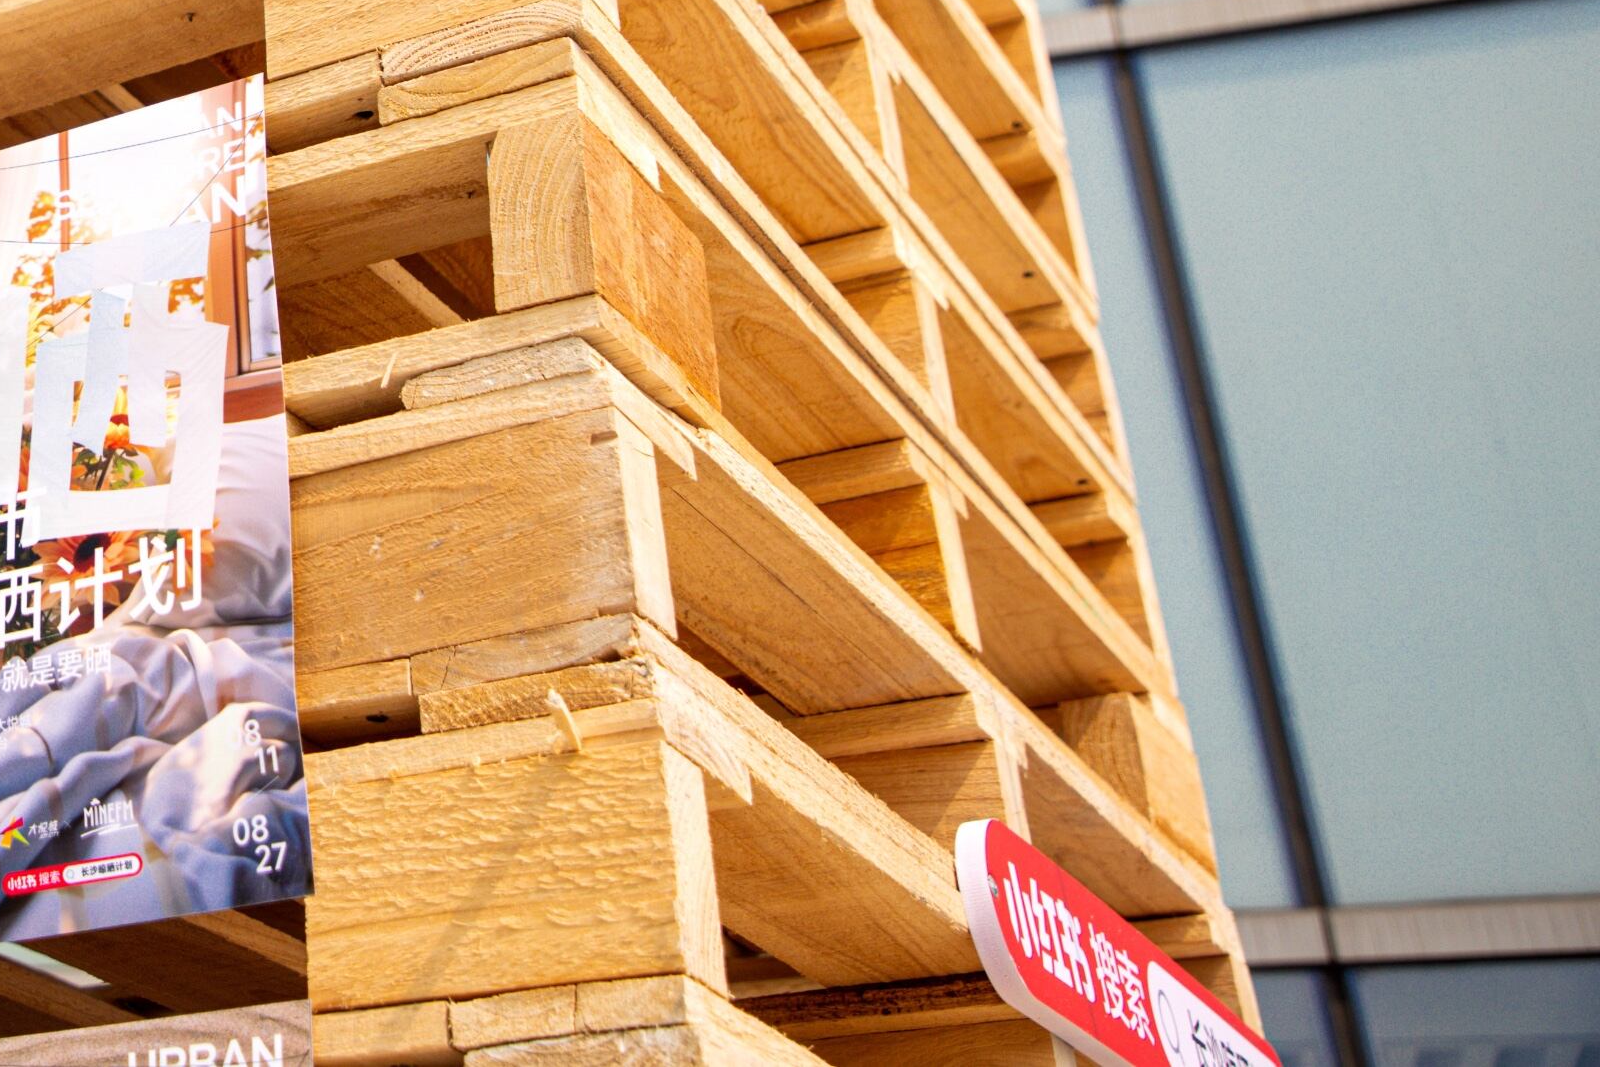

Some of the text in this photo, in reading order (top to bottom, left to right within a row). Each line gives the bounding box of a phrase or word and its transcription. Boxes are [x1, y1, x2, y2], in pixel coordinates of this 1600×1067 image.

[254, 745, 280, 775] 11
[232, 814, 269, 846] 08
[254, 841, 287, 875] 27
[1003, 860, 1096, 1004] 小红书
[1088, 922, 1156, 1046] 搜索
